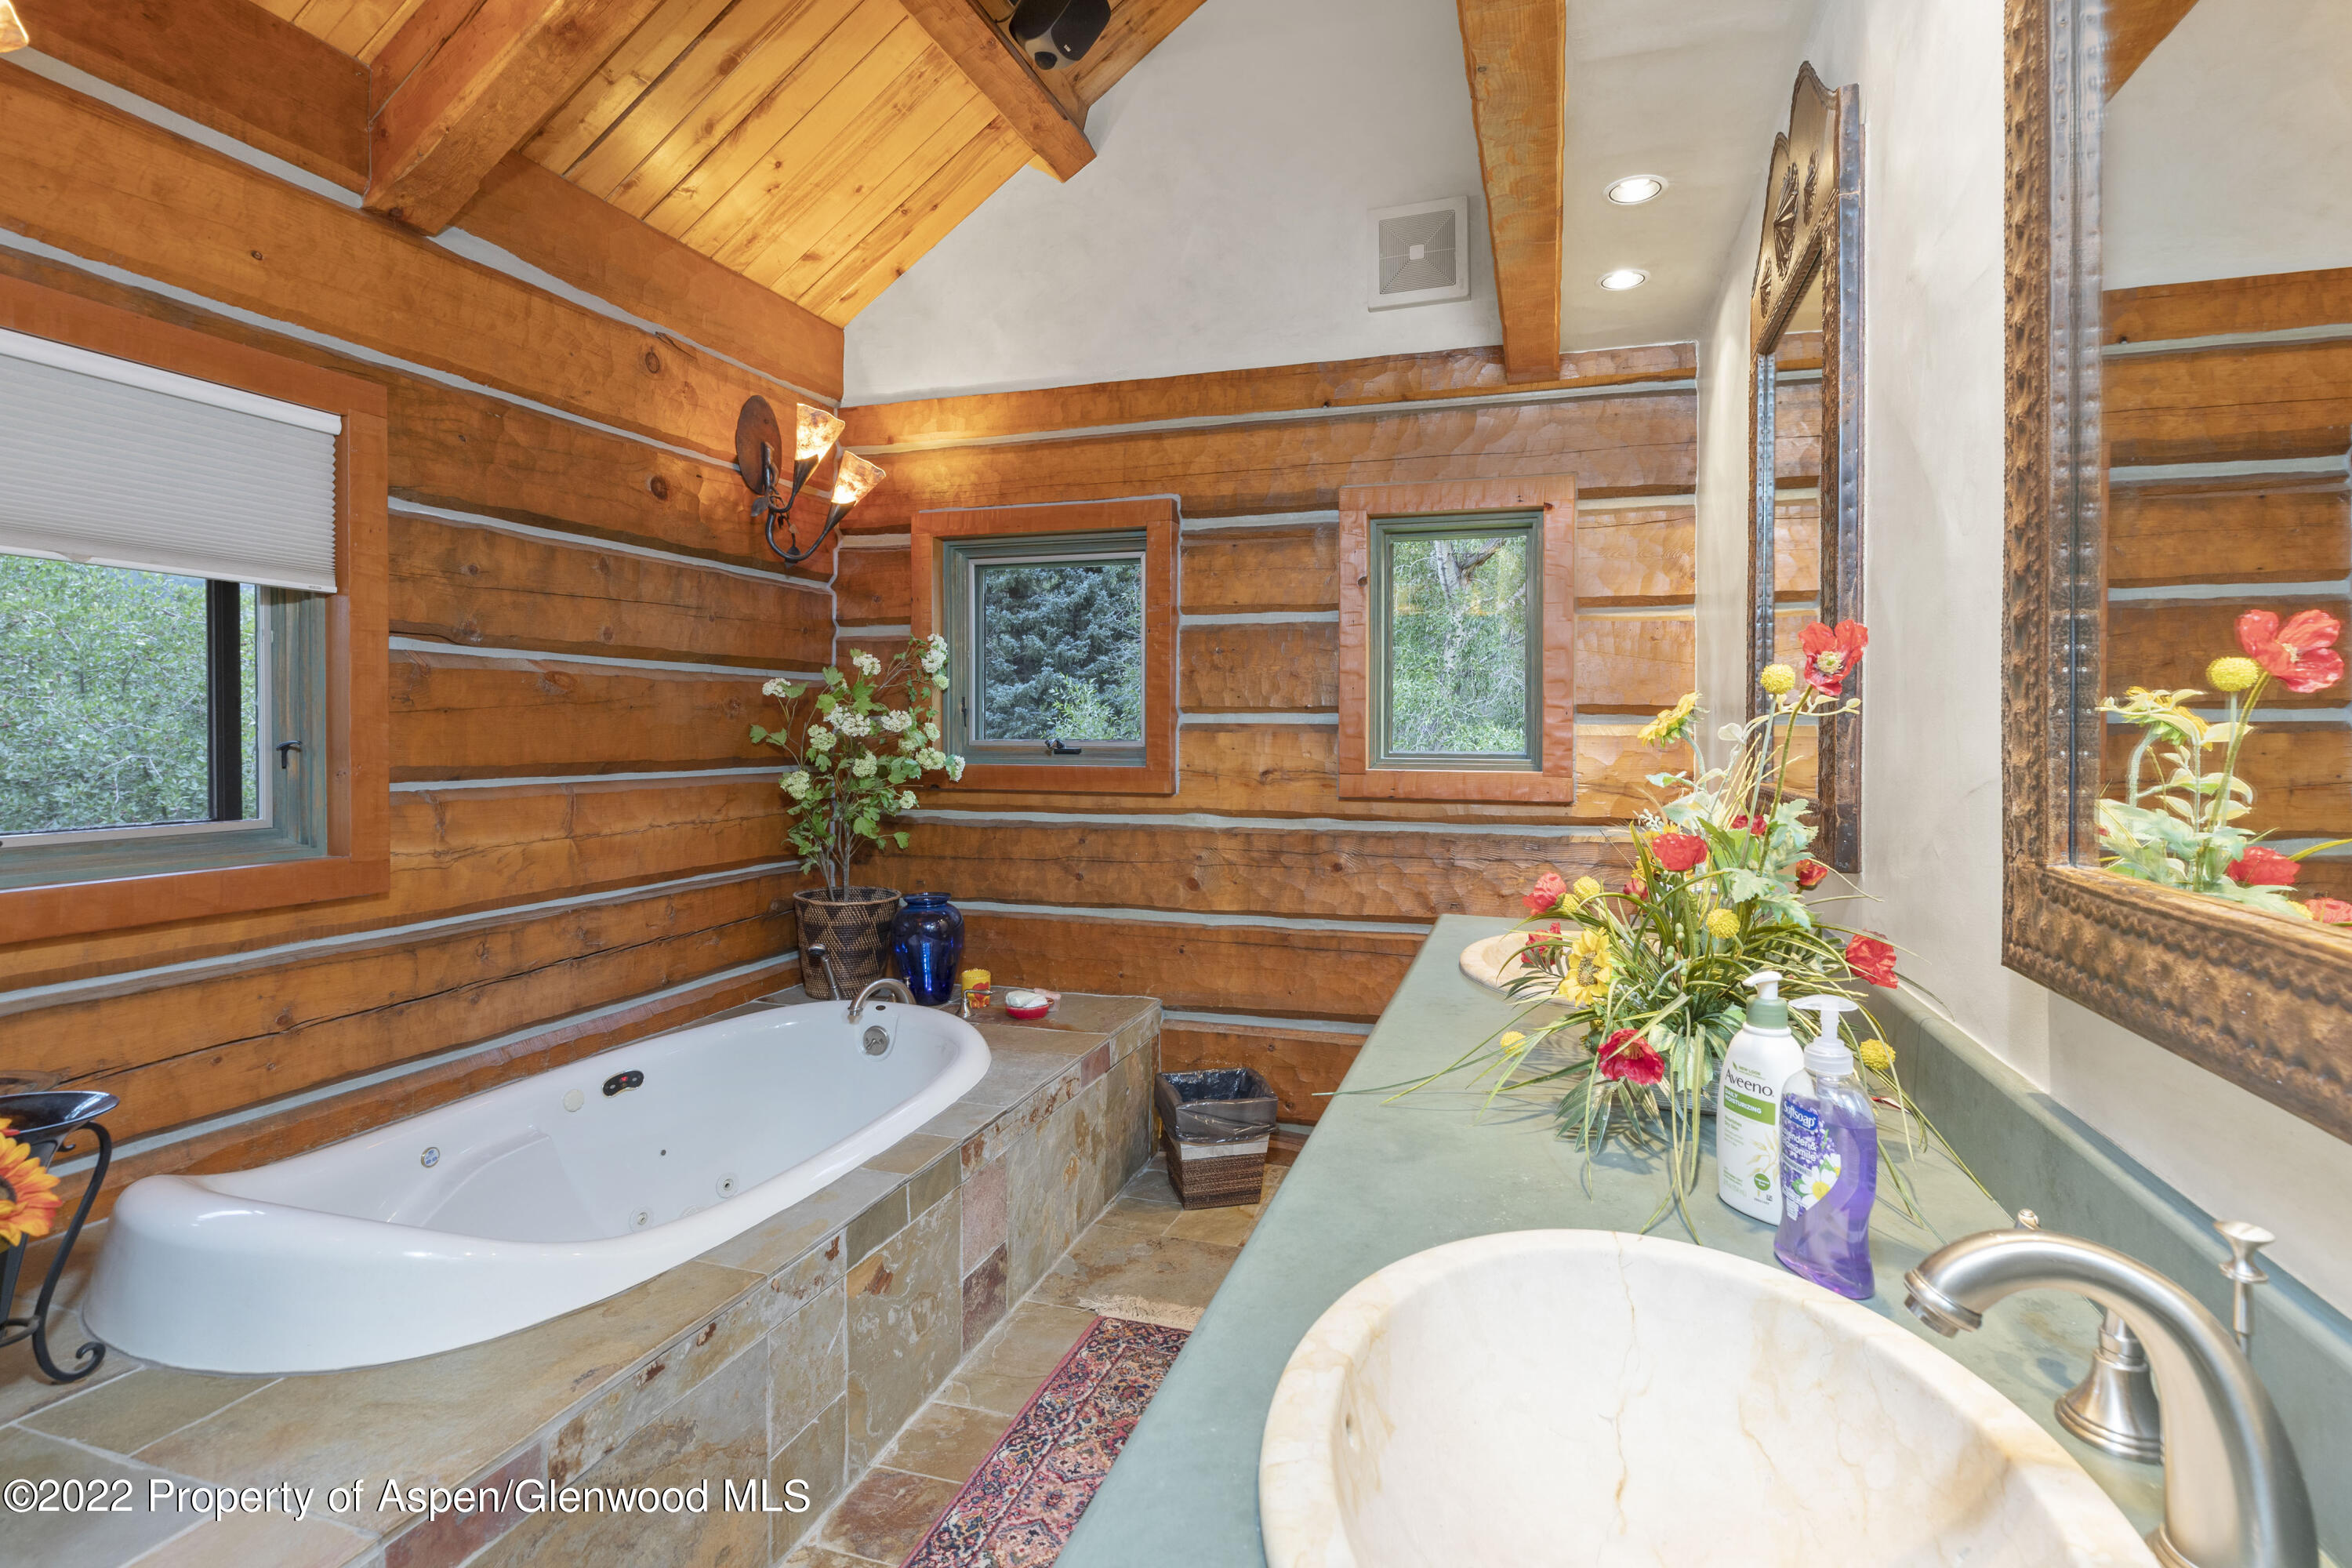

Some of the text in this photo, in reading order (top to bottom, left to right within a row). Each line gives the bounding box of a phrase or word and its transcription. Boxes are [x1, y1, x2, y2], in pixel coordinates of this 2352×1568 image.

[1725, 1068, 1773, 1097] Aveeno
[1725, 1088, 1738, 1099] DAILY
[1724, 1094, 1762, 1114] MOISTURIZING
[1784, 1100, 1815, 1129] Softsoap
